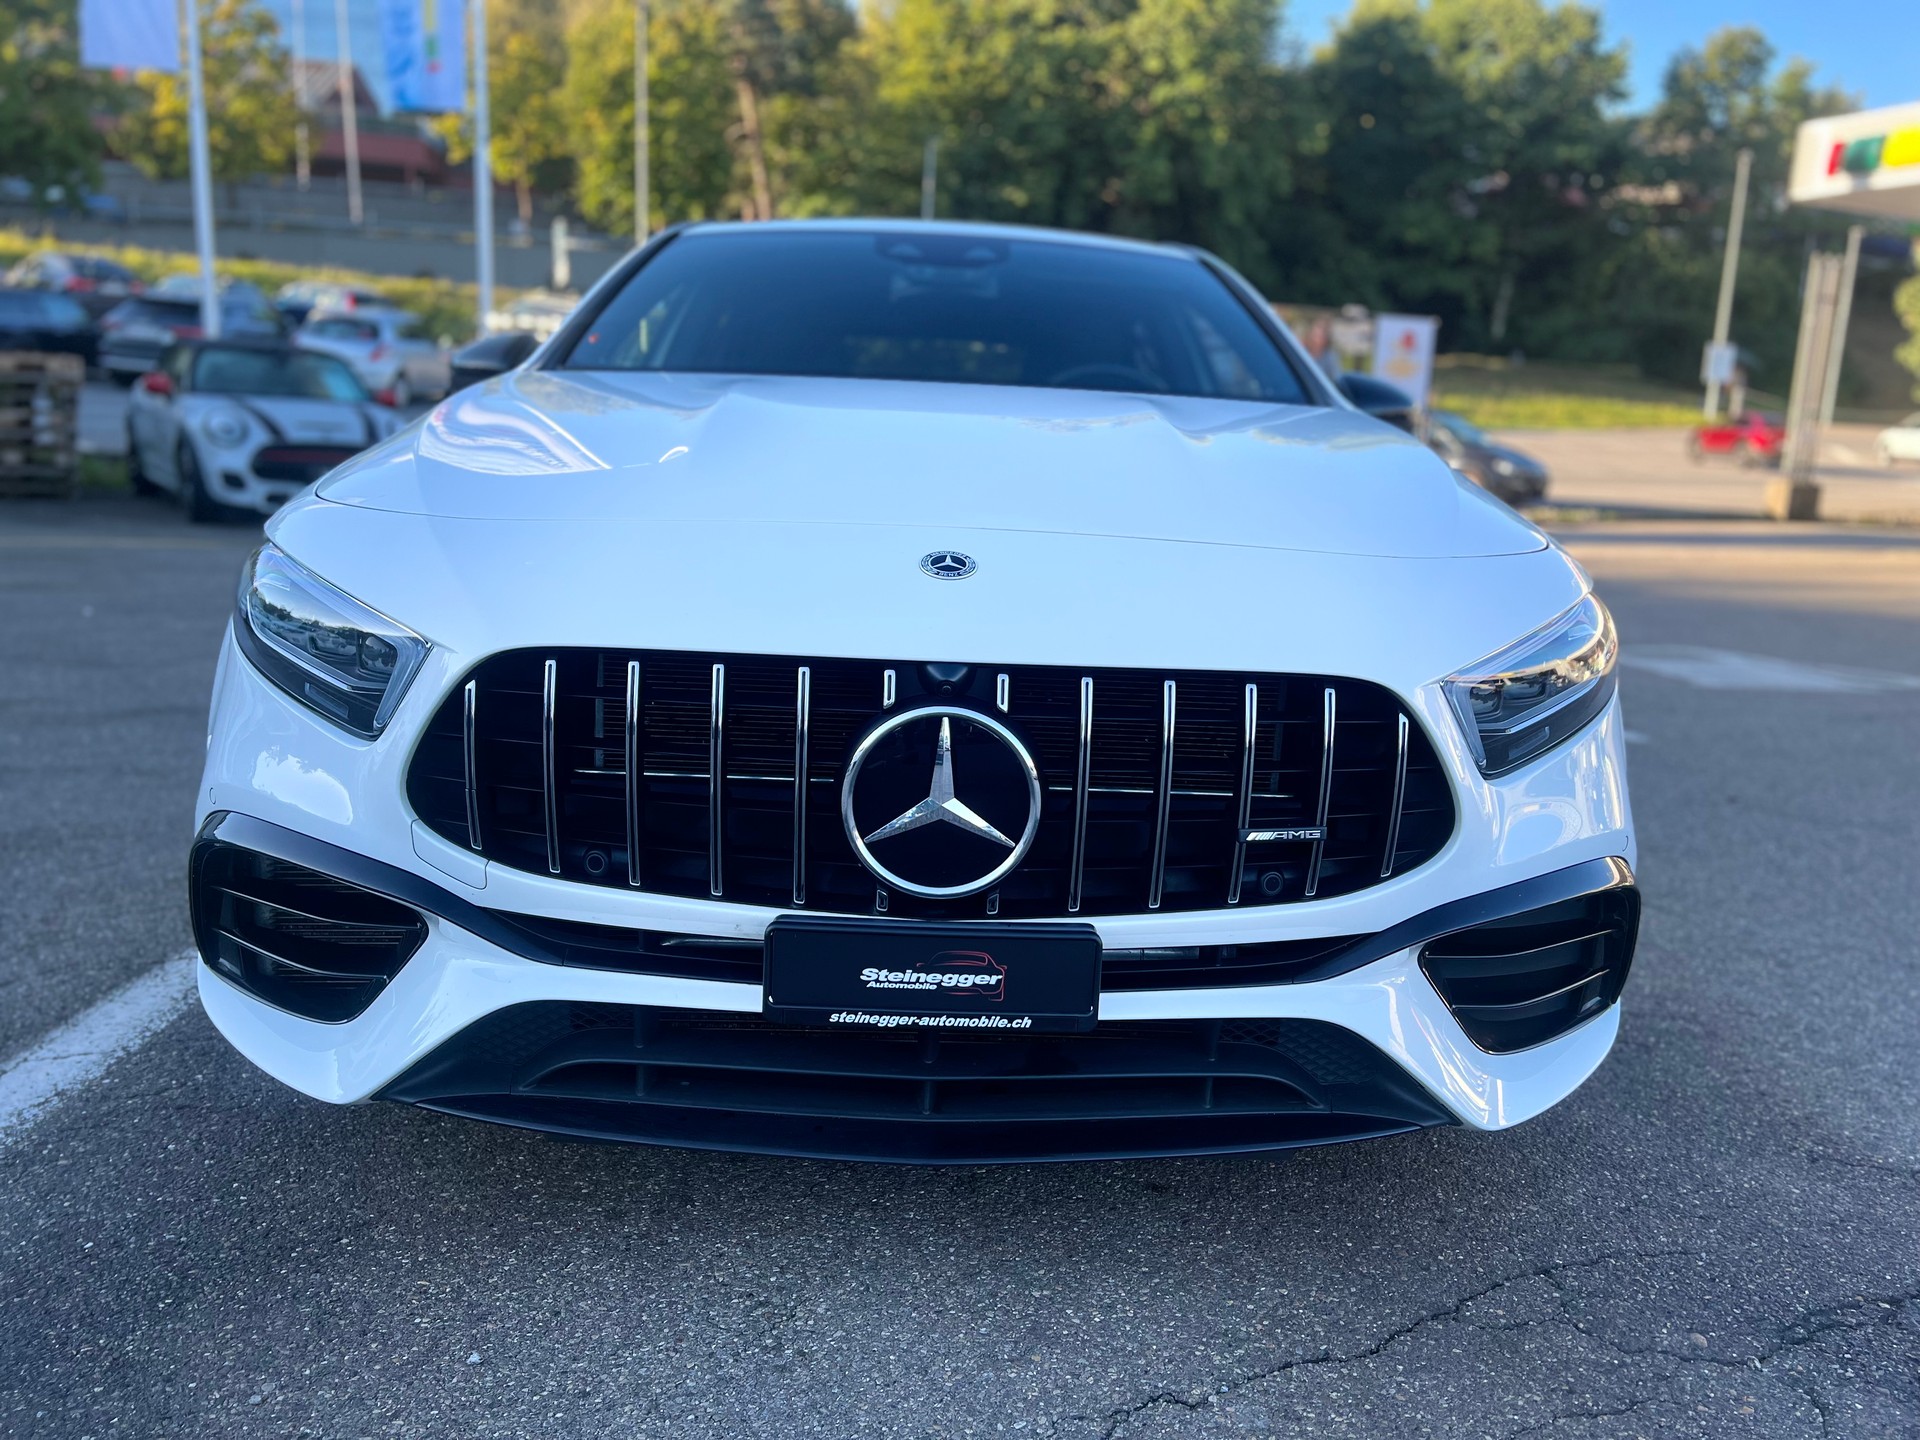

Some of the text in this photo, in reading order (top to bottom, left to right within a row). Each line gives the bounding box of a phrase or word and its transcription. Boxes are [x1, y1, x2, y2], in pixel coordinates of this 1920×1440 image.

[1269, 830, 1321, 840] AMG
[860, 967, 1003, 988] Steinegger
[866, 981, 938, 990] Automobile
[829, 1011, 1032, 1028] steinegger-automobile.ch
